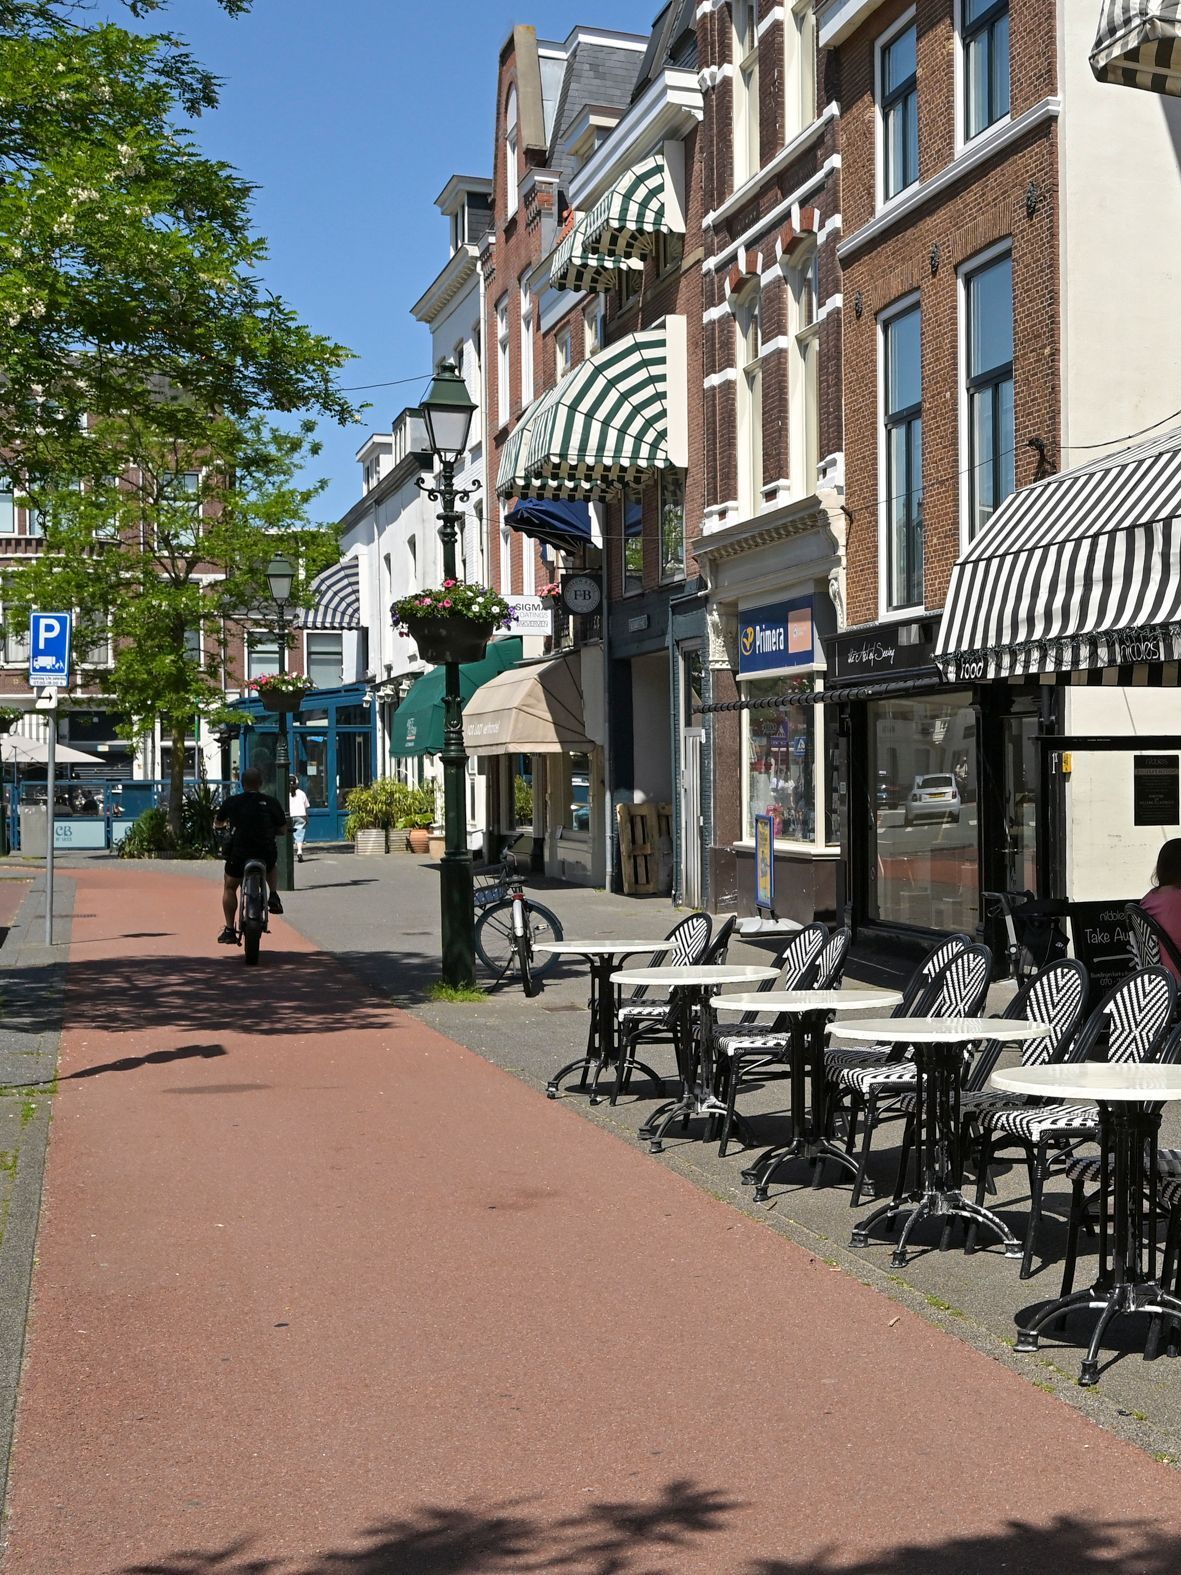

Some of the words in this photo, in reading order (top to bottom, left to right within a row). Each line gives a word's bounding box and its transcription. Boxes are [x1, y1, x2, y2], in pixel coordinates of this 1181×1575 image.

[39, 618, 60, 650] P
[755, 625, 784, 654] Primera
[1099, 910, 1127, 921] nibble
[1084, 928, 1110, 944] Take
